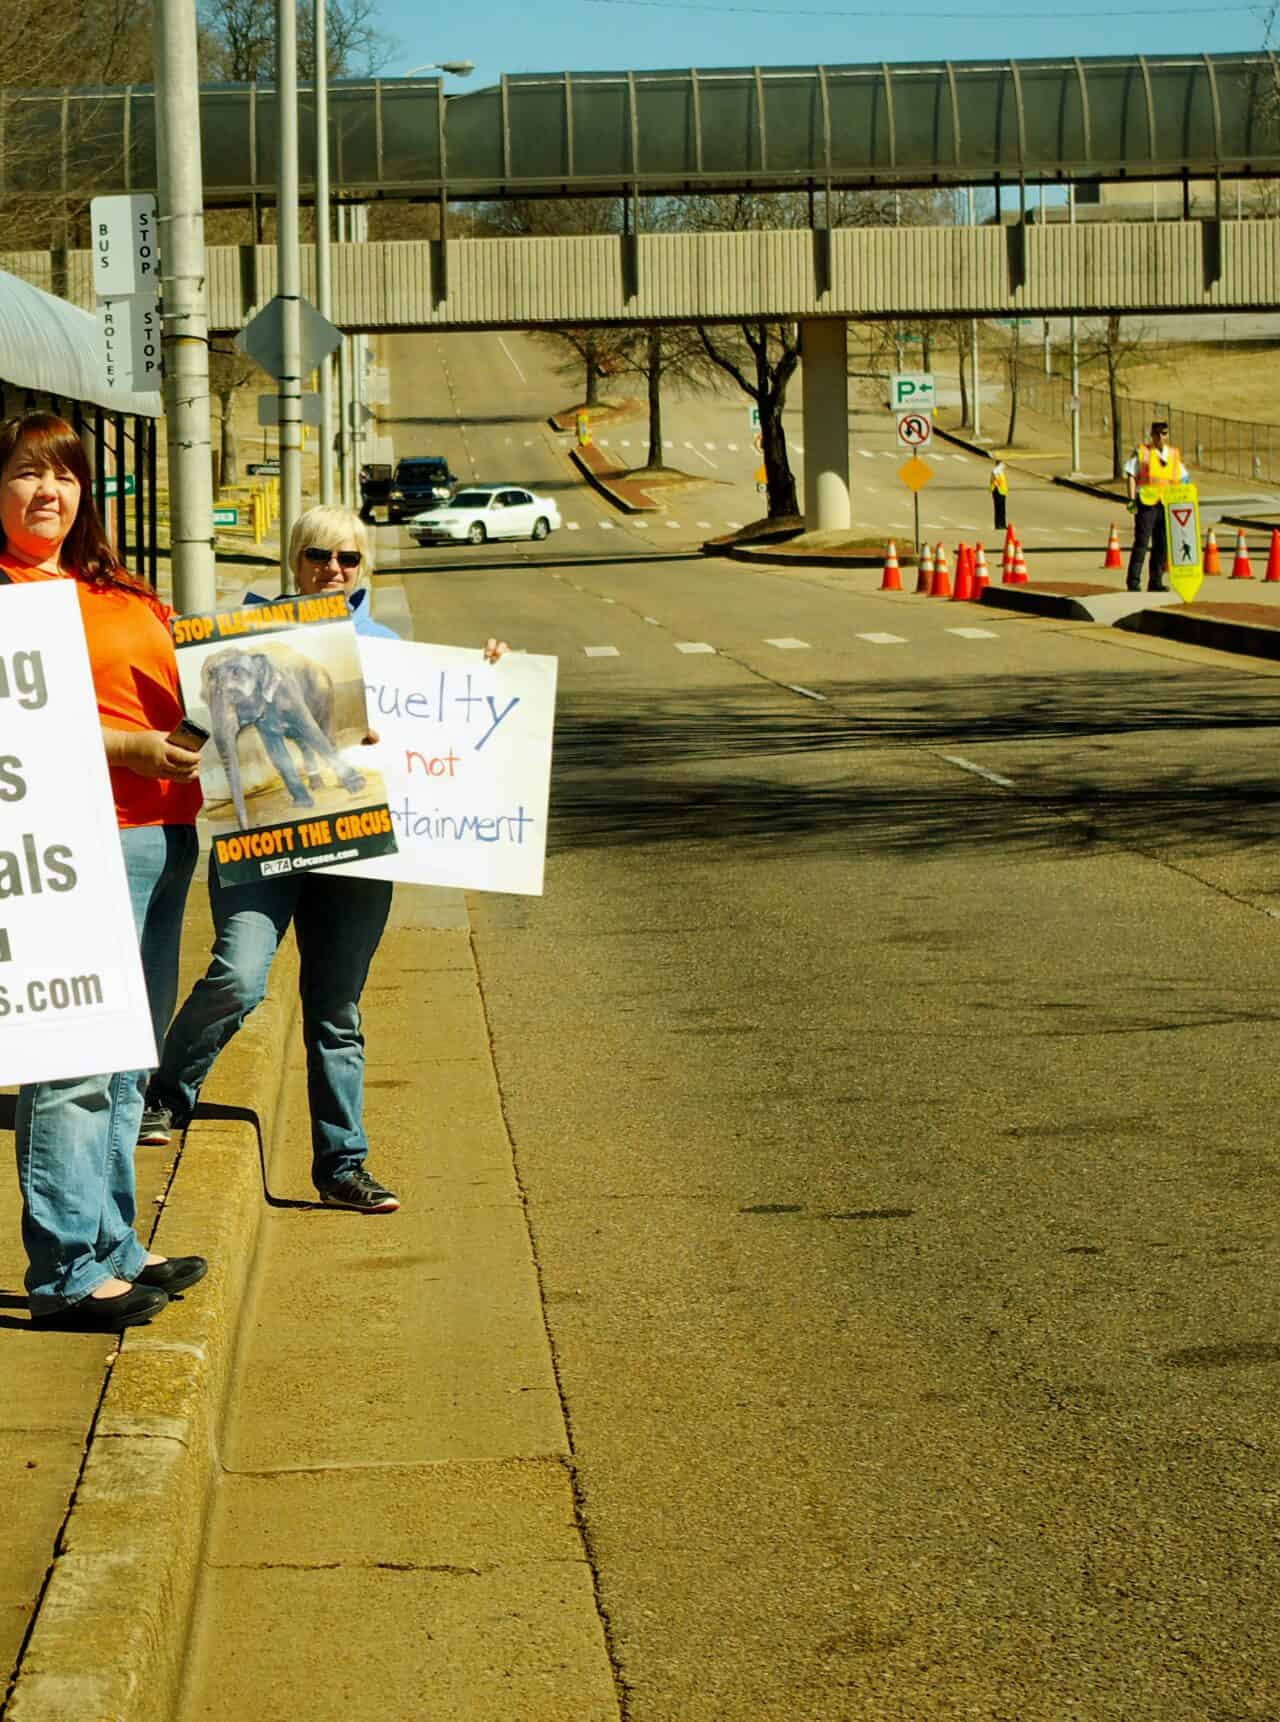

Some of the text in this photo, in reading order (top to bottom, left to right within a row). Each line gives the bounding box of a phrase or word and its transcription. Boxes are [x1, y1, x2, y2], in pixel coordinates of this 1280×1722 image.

[99, 224, 110, 268] BUS
[139, 213, 151, 274] STOP
[104, 301, 116, 387] TROLLEY
[143, 312, 155, 373] STOP
[897, 381, 916, 403] P
[173, 616, 214, 644] STOP
[298, 593, 349, 623] ABUSE
[405, 746, 463, 777] not
[216, 808, 392, 864] BOYCOTT THE CIRCUS
